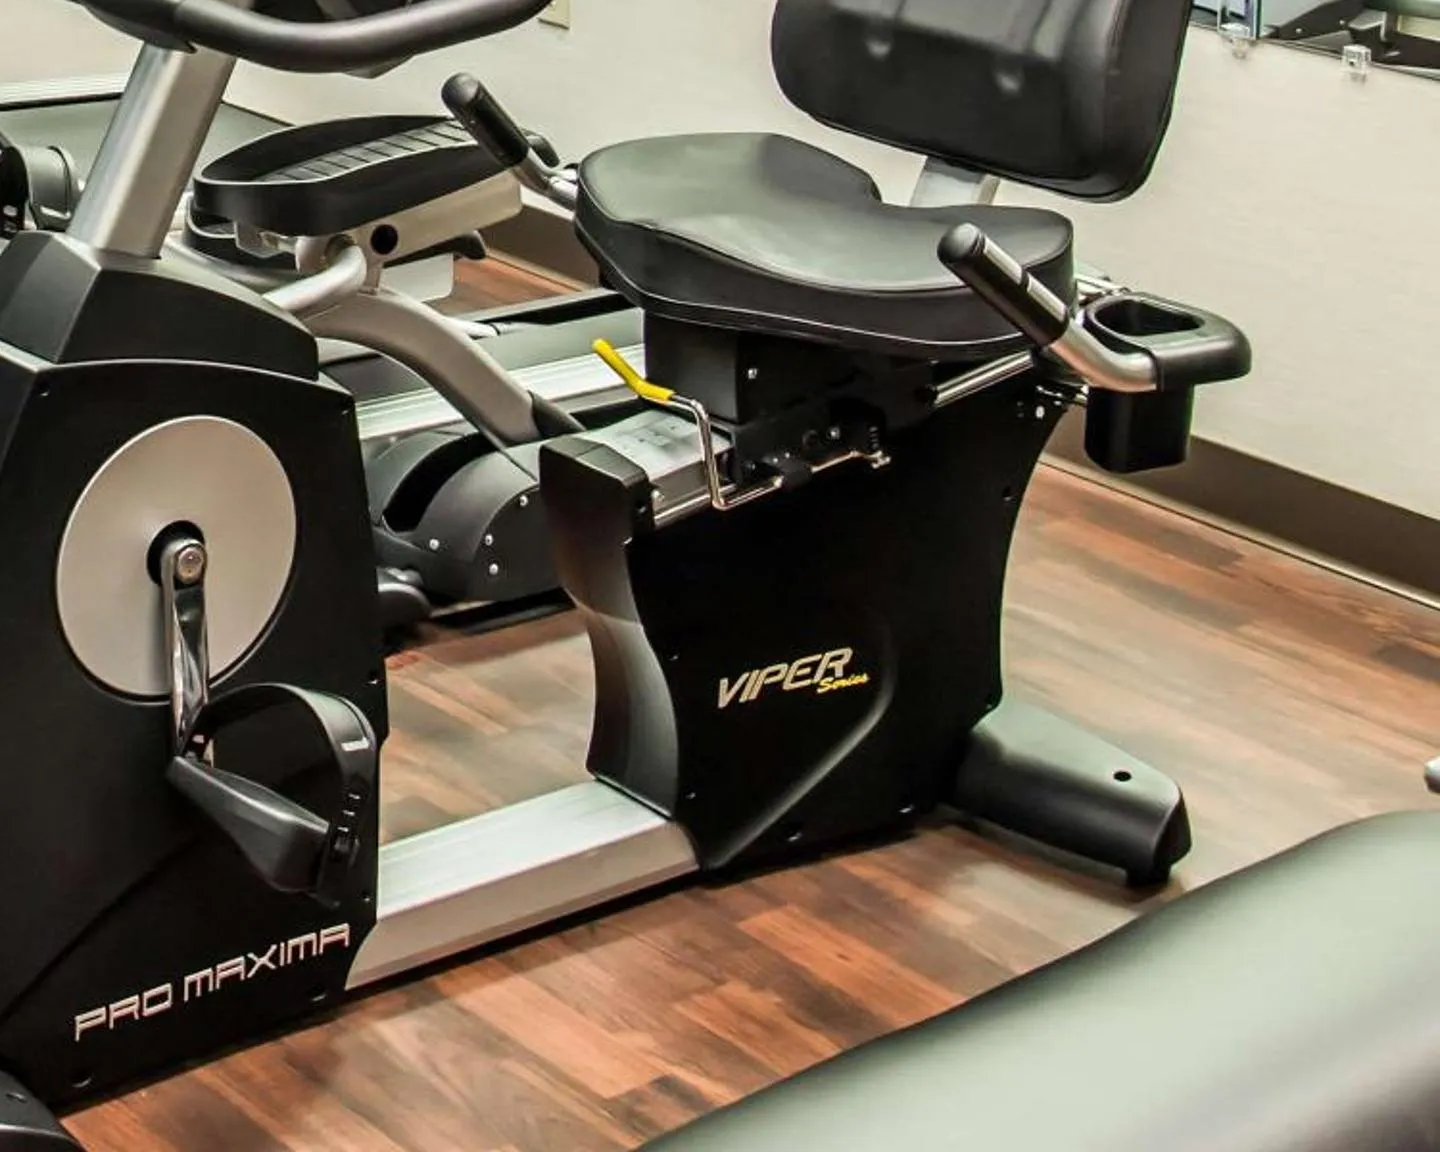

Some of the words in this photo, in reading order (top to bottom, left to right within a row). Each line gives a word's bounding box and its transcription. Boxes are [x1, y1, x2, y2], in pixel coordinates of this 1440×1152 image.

[717, 646, 854, 710] VIPER
[73, 982, 173, 1043] PRO
[183, 922, 351, 1003] MAXIMA
